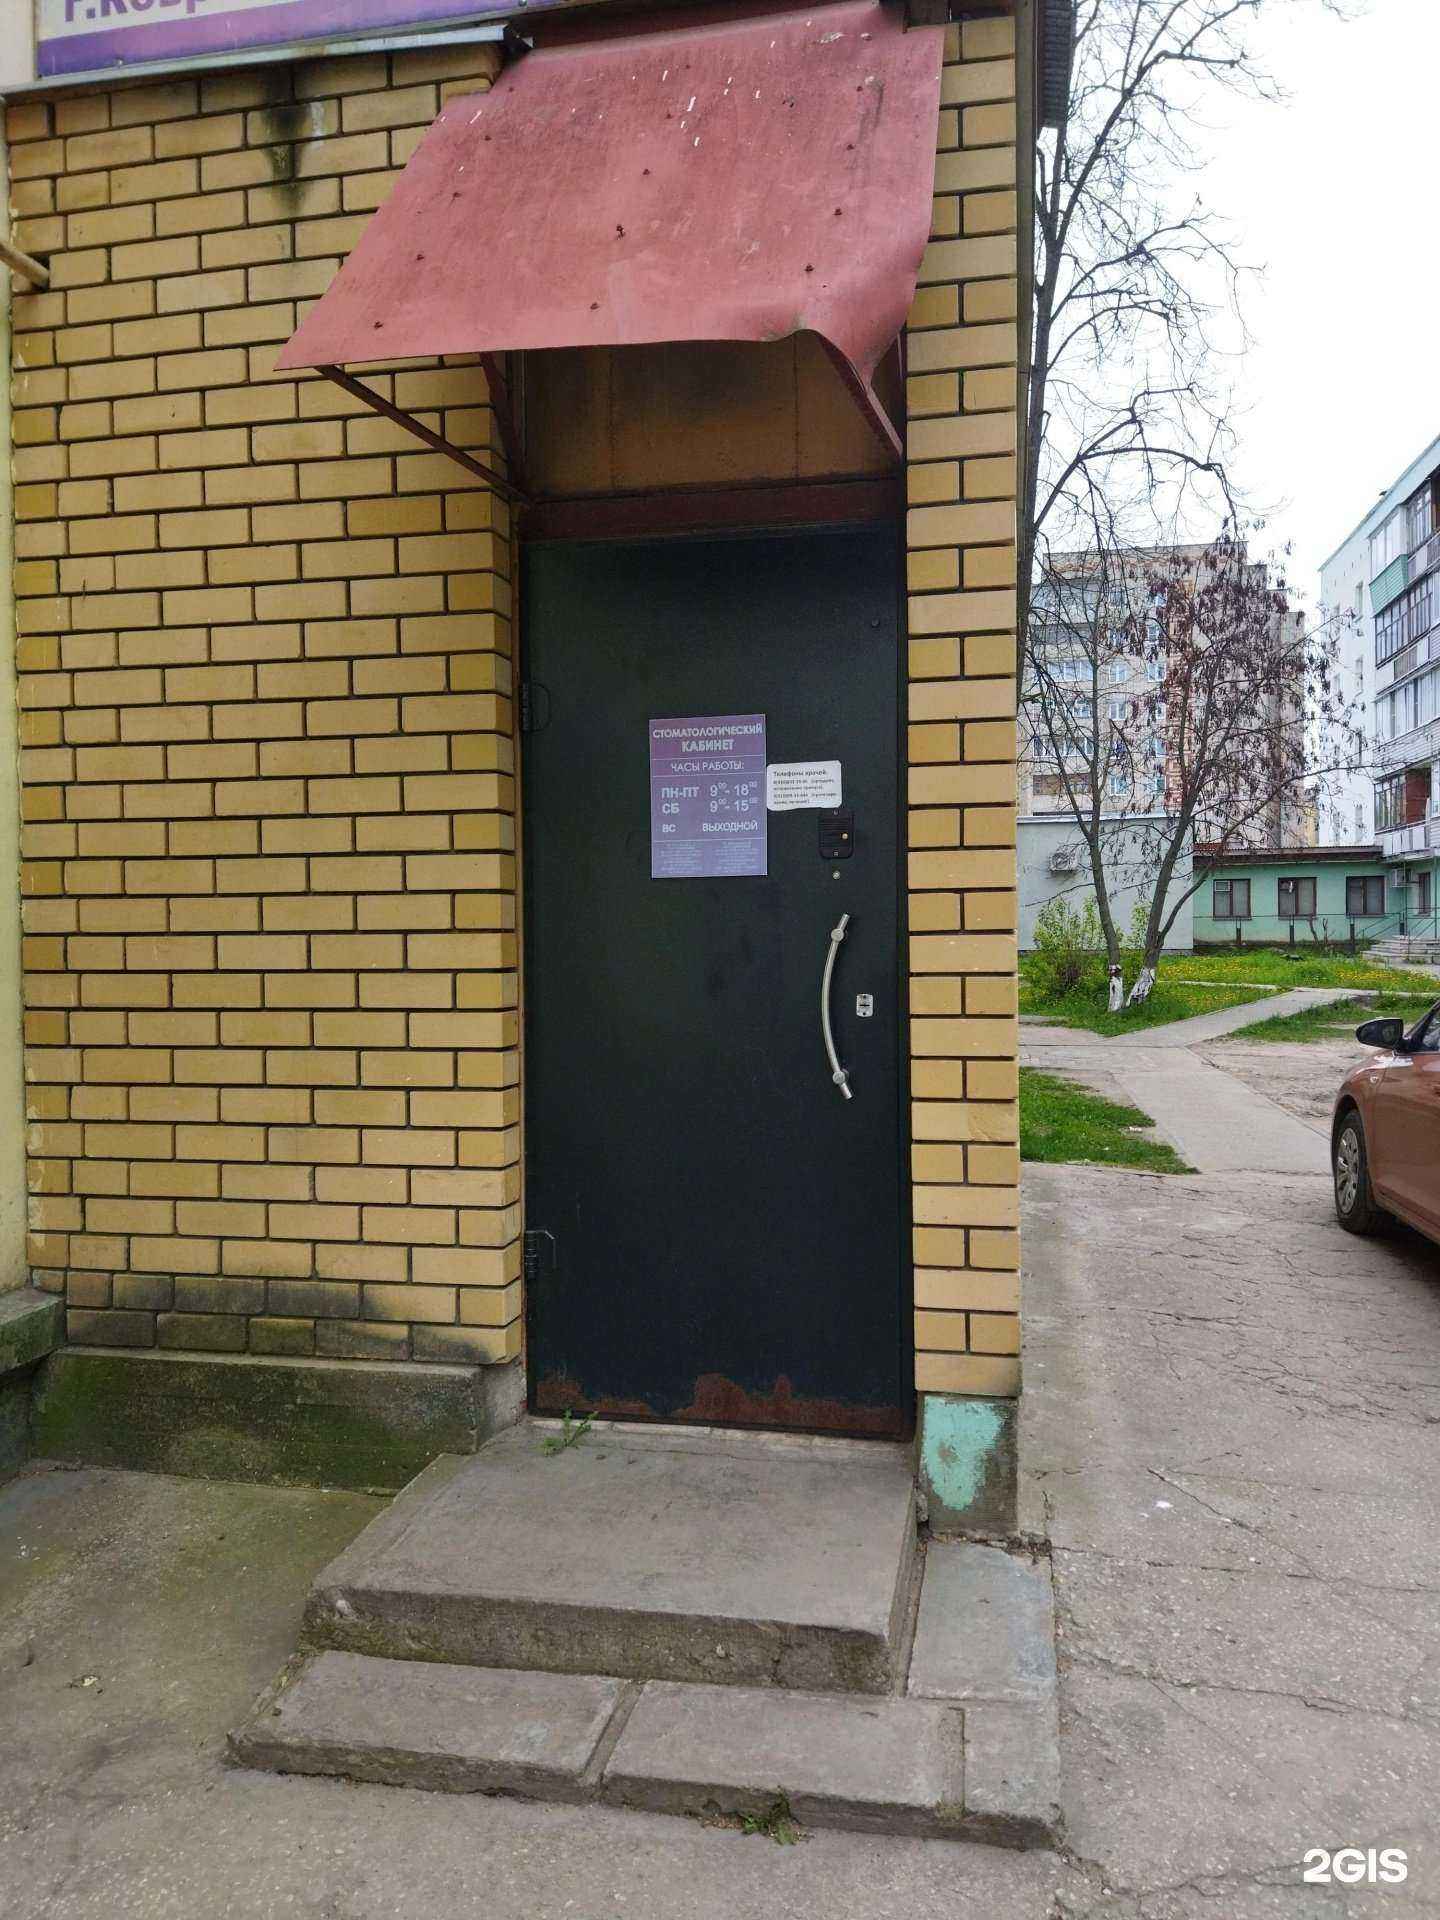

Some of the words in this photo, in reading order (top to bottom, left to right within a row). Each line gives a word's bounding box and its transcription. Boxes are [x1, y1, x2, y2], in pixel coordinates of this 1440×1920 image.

[653, 723, 762, 738] СТОМАТОЛОГИЧЕСКИЙ
[682, 739, 734, 752] КАБИНЕТ
[671, 762, 700, 772] ЧАСЫ
[703, 760, 744, 771] РАБОТЫ:
[661, 787, 699, 798] ПН-ПТ
[662, 802, 680, 814] СБ
[662, 823, 676, 833] ВС
[702, 820, 758, 833] ВЫХОДНОЙ
